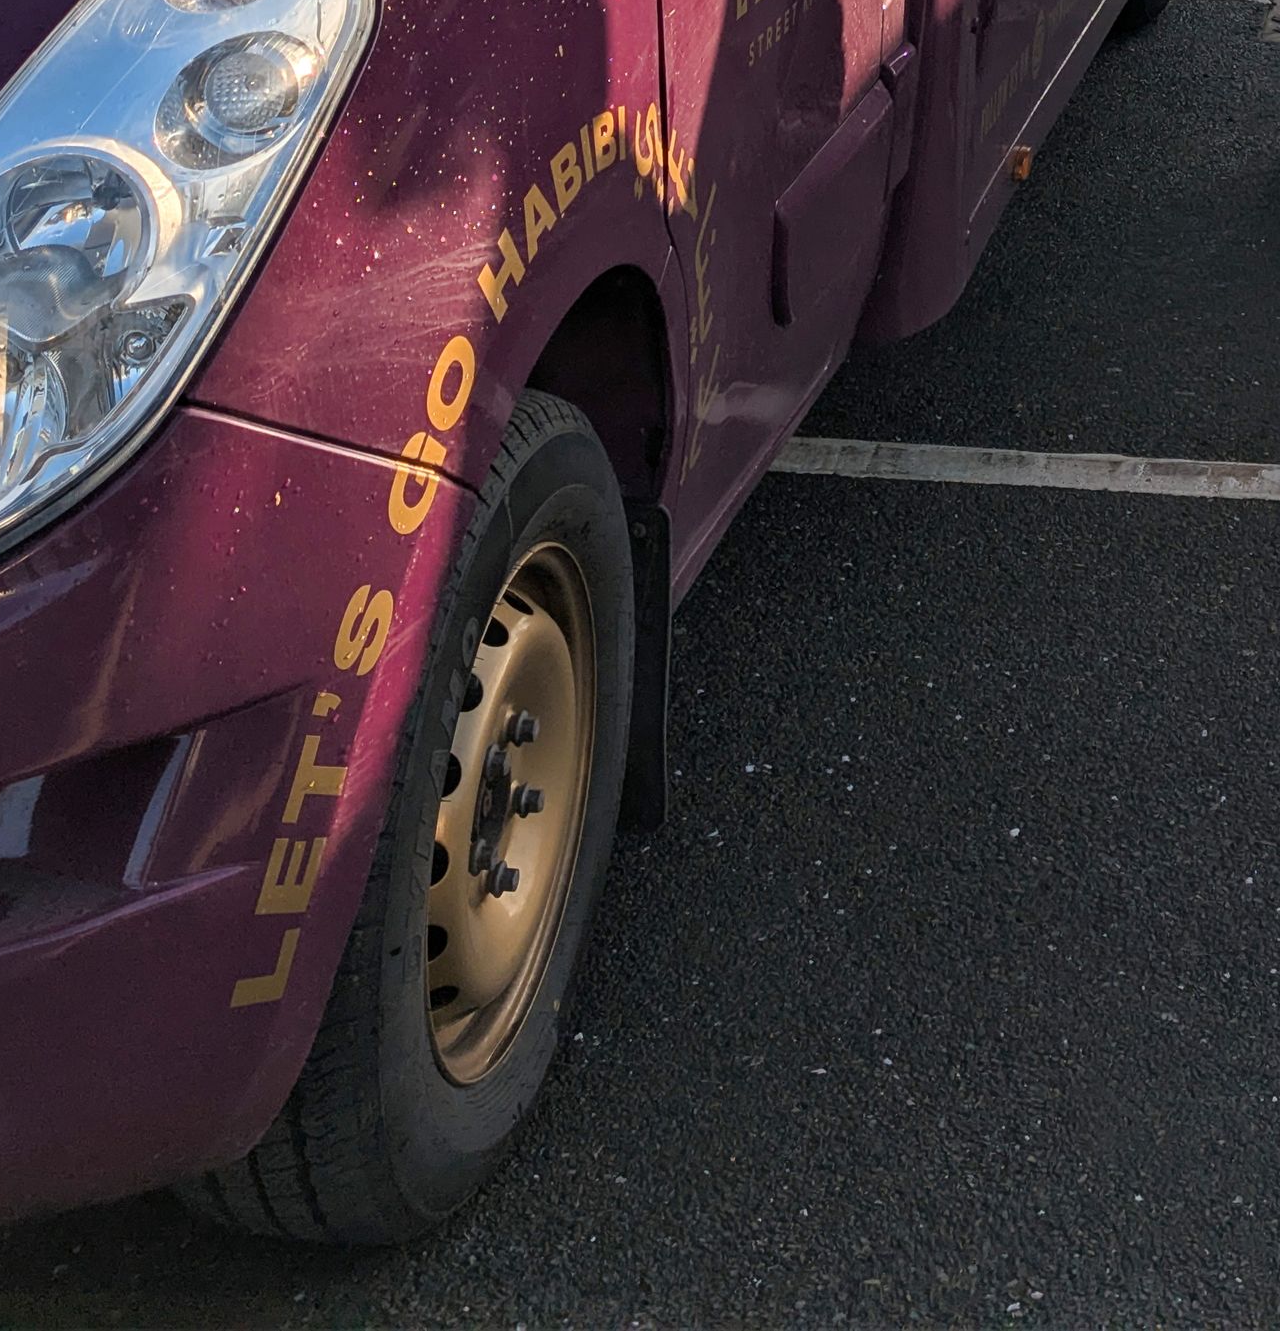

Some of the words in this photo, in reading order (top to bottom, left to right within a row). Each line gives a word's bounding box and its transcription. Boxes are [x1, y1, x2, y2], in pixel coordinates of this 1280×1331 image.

[747, 2, 798, 68] STREET
[229, 582, 394, 1009] LET'S
[387, 334, 477, 536] GO
[477, 104, 628, 323] HABIBI
